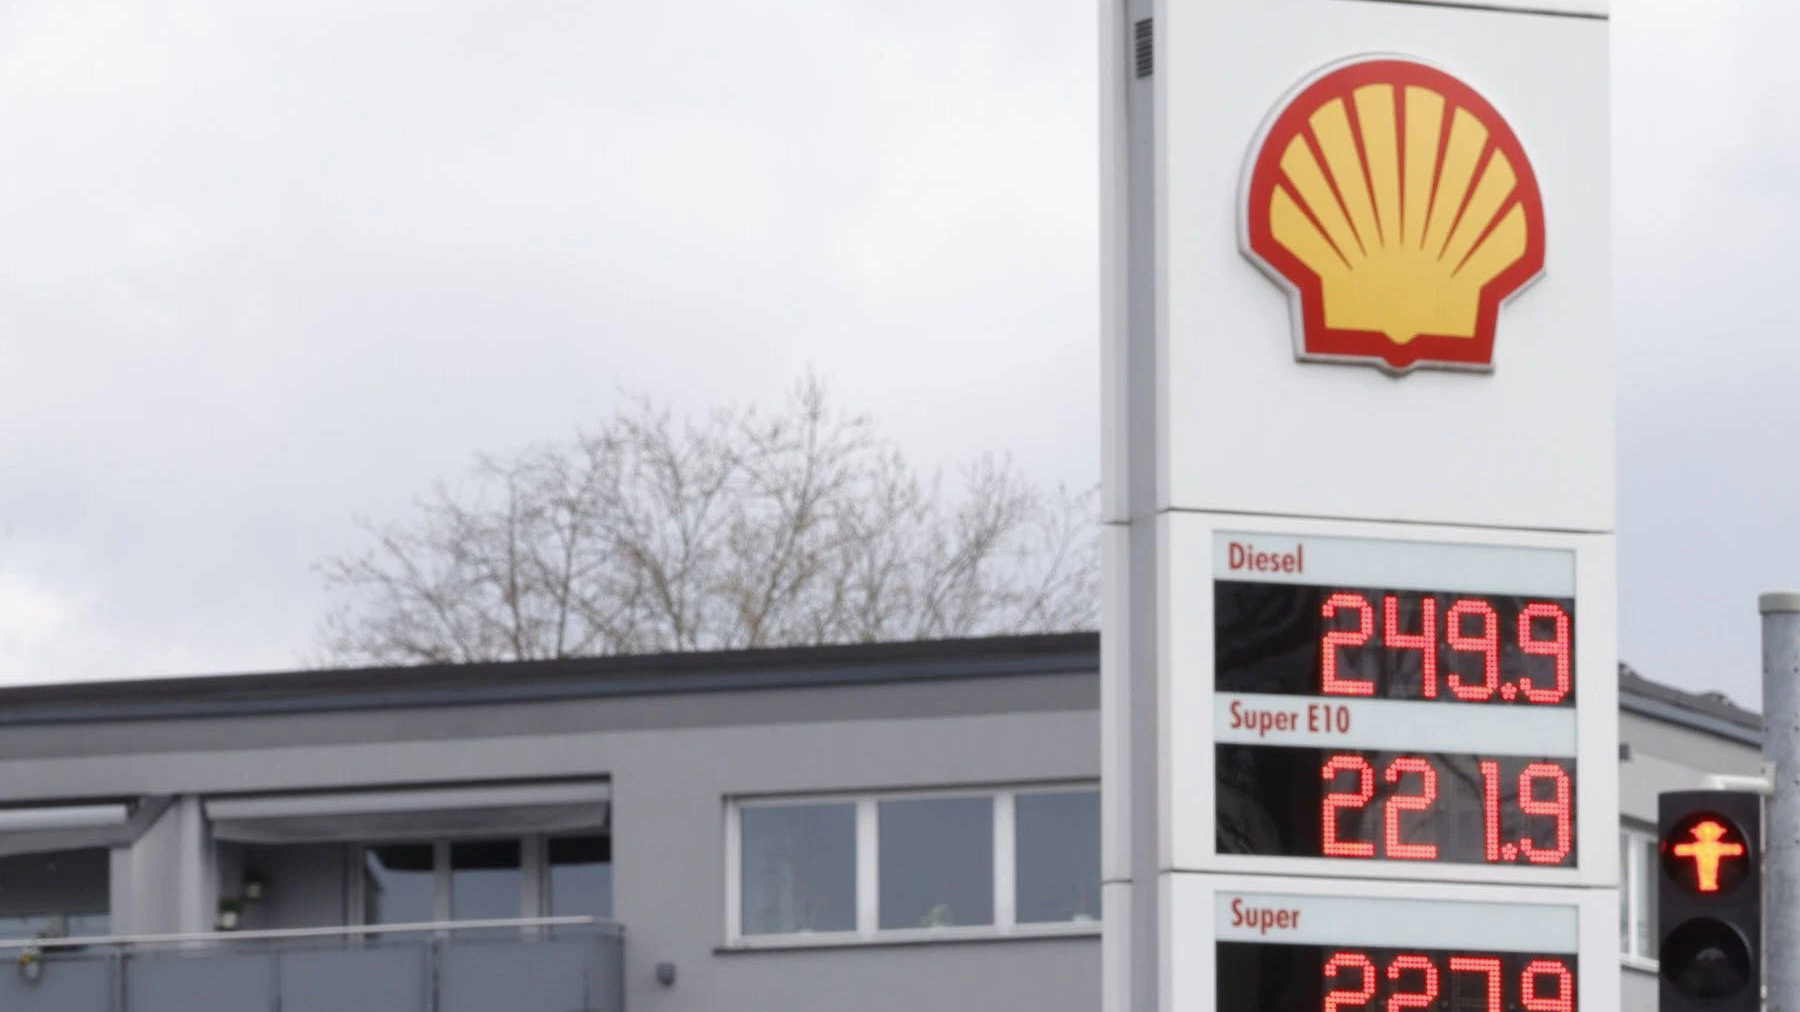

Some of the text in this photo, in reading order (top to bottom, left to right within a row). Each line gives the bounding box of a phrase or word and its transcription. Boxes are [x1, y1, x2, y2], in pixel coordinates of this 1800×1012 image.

[1228, 542, 1304, 573] Diesel
[1321, 593, 1570, 704] 249.9
[1230, 701, 1352, 736] Super E10
[1321, 755, 1572, 864] 221.9
[1231, 897, 1301, 934] Super
